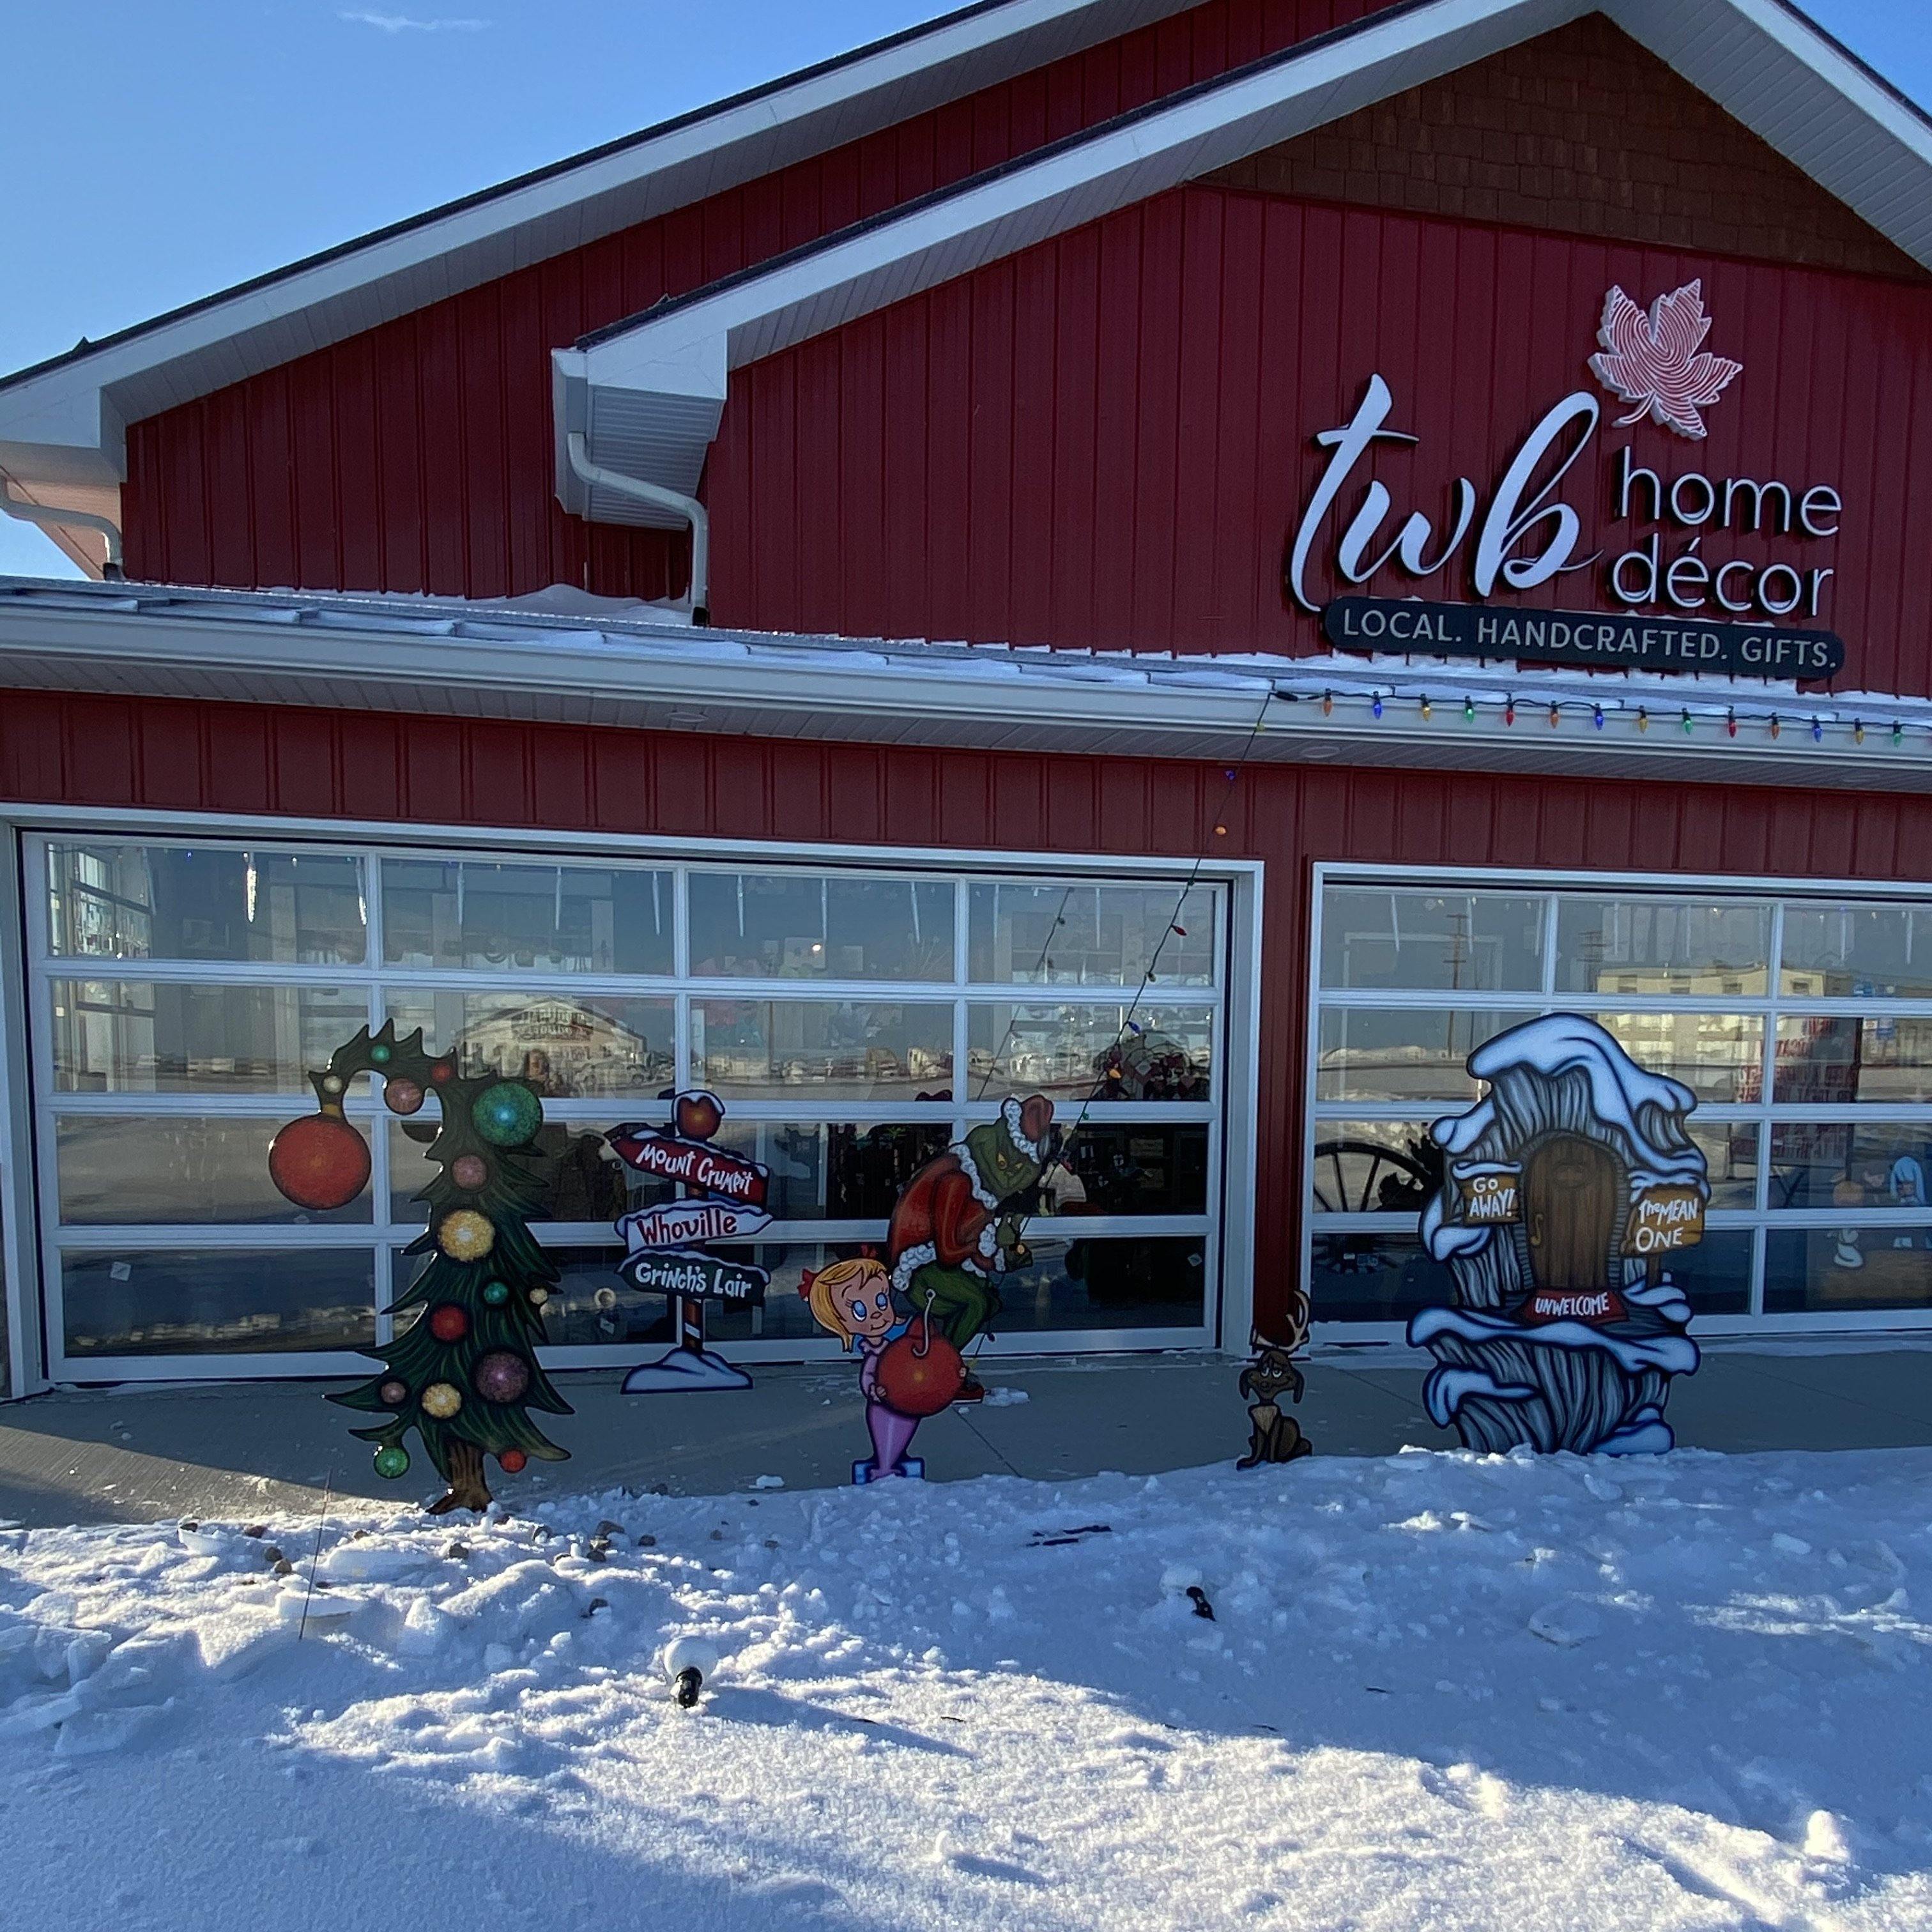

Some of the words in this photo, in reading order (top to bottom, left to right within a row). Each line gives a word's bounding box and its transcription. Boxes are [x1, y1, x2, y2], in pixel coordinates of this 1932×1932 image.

[1291, 372, 1604, 613] twb
[1620, 445, 1844, 537] home
[1612, 532, 1835, 617] décor
[1344, 608, 1462, 643] LOCAL.
[1477, 617, 1729, 660] HANDCRAFTED.
[1740, 636, 1837, 669] GIFTS.
[1469, 1188, 1516, 1219] AWAY!
[1656, 1197, 1699, 1226] MEAN
[636, 1208, 738, 1245] Whoville
[1636, 1226, 1685, 1253] ONE
[713, 1268, 753, 1299] Lair
[1535, 1291, 1610, 1317] UNWELCOME
